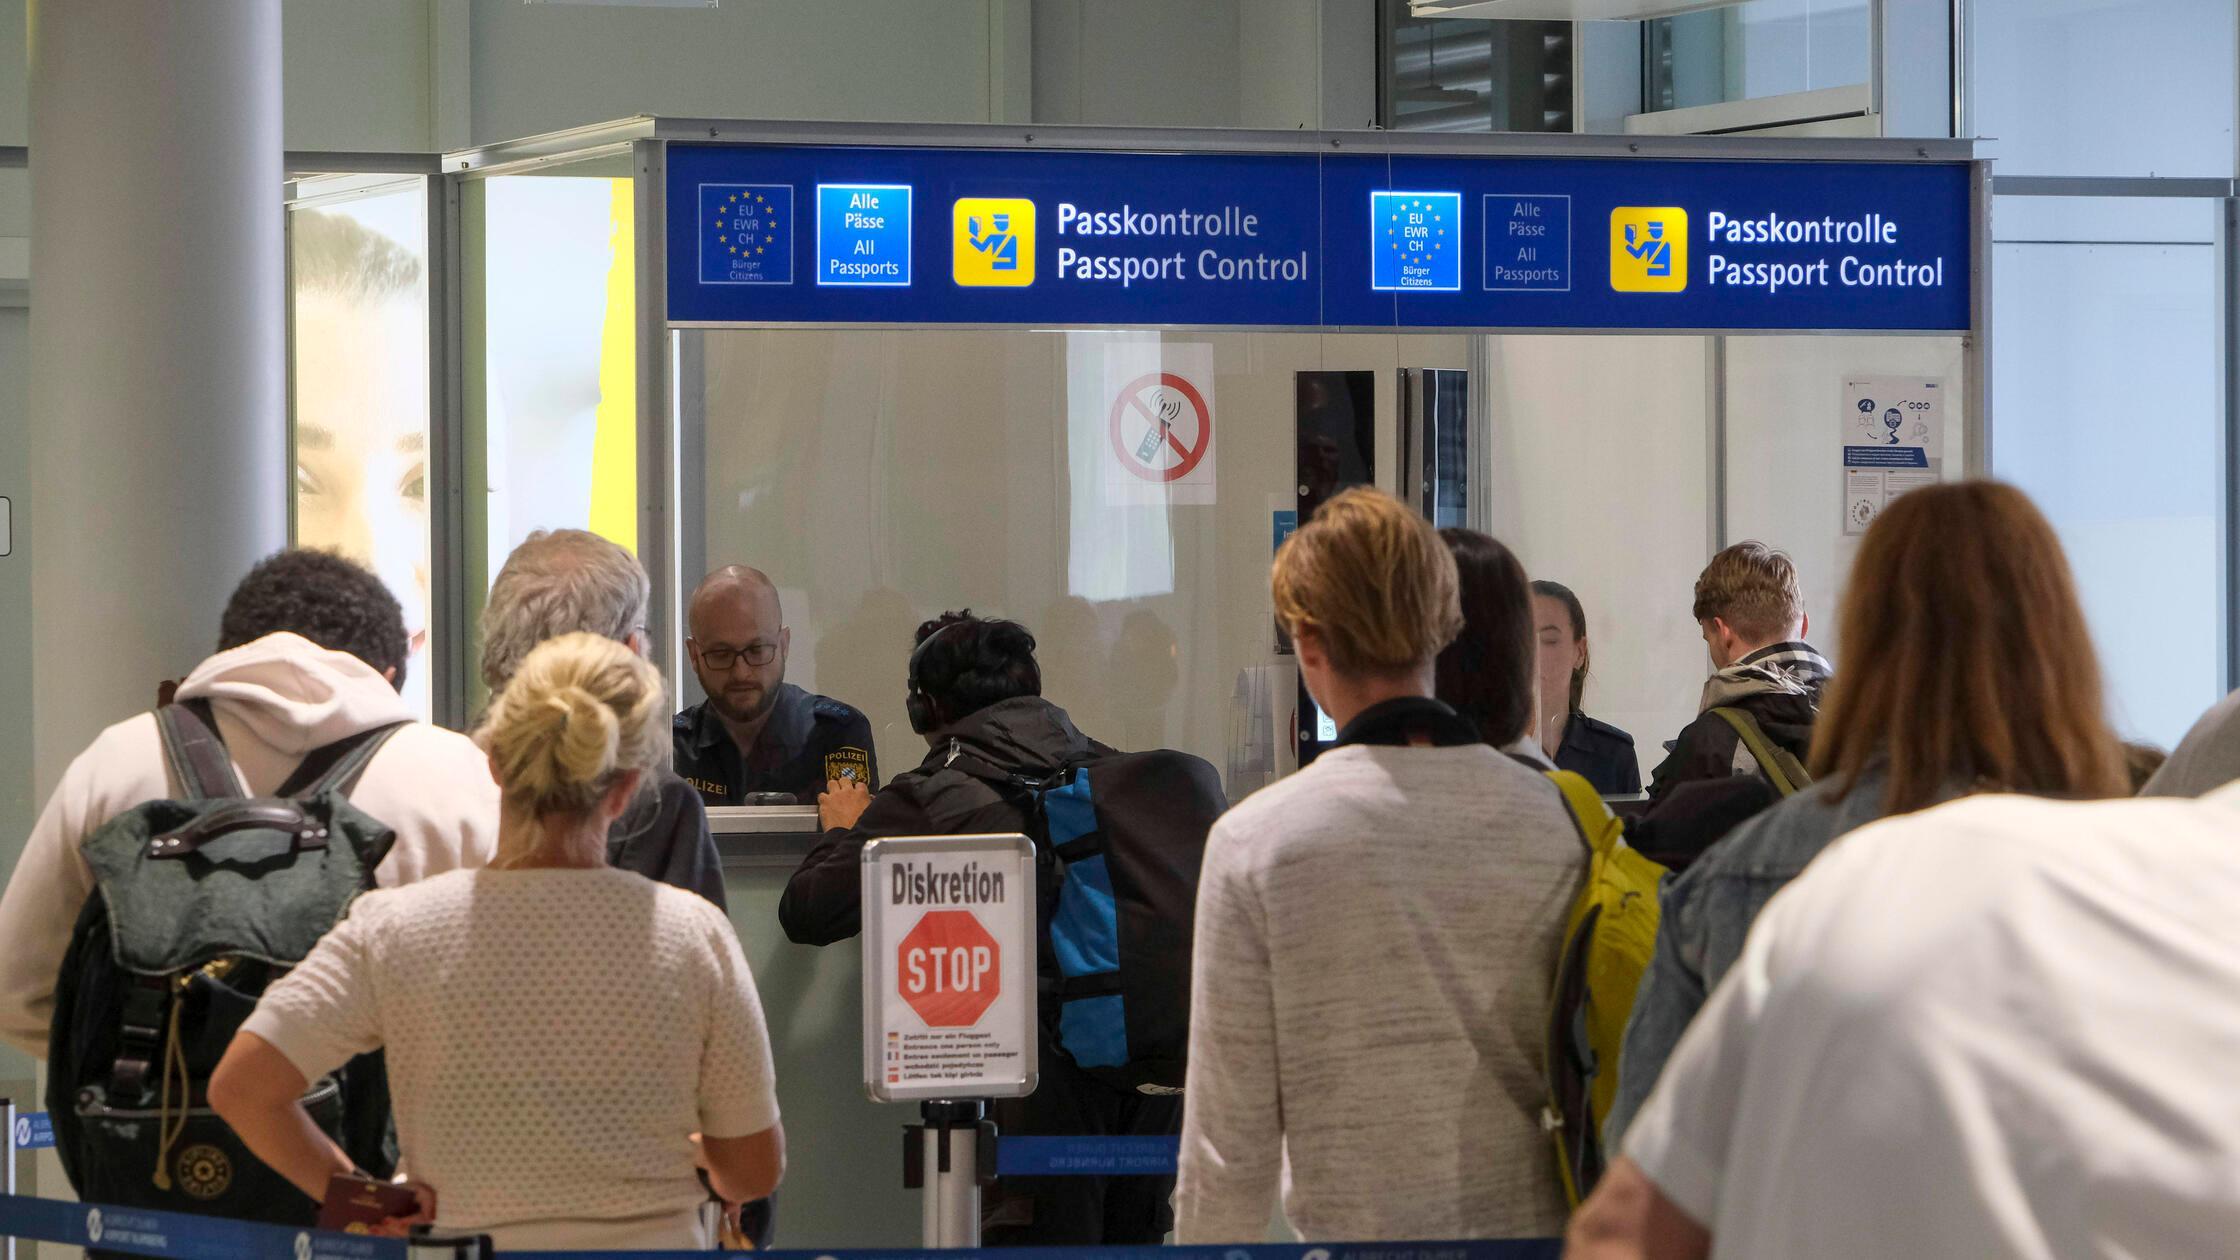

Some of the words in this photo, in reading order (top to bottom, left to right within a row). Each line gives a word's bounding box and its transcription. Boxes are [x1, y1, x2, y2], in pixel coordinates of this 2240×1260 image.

[849, 192, 880, 210] Alle
[738, 204, 754, 217] EU
[1513, 202, 1541, 217] Alle
[733, 218, 759, 231] EWR
[844, 212, 885, 230] Pässe
[1057, 202, 1259, 237] Passkontrolle
[1409, 212, 1424, 225] EU
[1404, 226, 1429, 238] EWR
[1509, 220, 1546, 236] Pässe
[1708, 211, 1897, 244] Passkontrolle
[738, 232, 754, 245] CH
[1408, 239, 1424, 252] CH
[853, 239, 875, 255] All
[1517, 247, 1536, 262] All
[731, 258, 761, 272] Bürger
[829, 259, 899, 278] Passports
[1057, 247, 1186, 289] Passport
[1196, 249, 1308, 282] Control
[1402, 265, 1431, 279] Bürger
[729, 269, 764, 281] Citizens
[1494, 265, 1560, 284] Passports
[1708, 254, 1829, 294] Passport
[1838, 255, 1944, 288] Control
[1400, 277, 1433, 288] Citizens
[829, 752, 865, 762] POLIZEI
[687, 777, 727, 796] OLIZEI
[892, 862, 1005, 905] Diskretion
[908, 946, 991, 993] STOP
